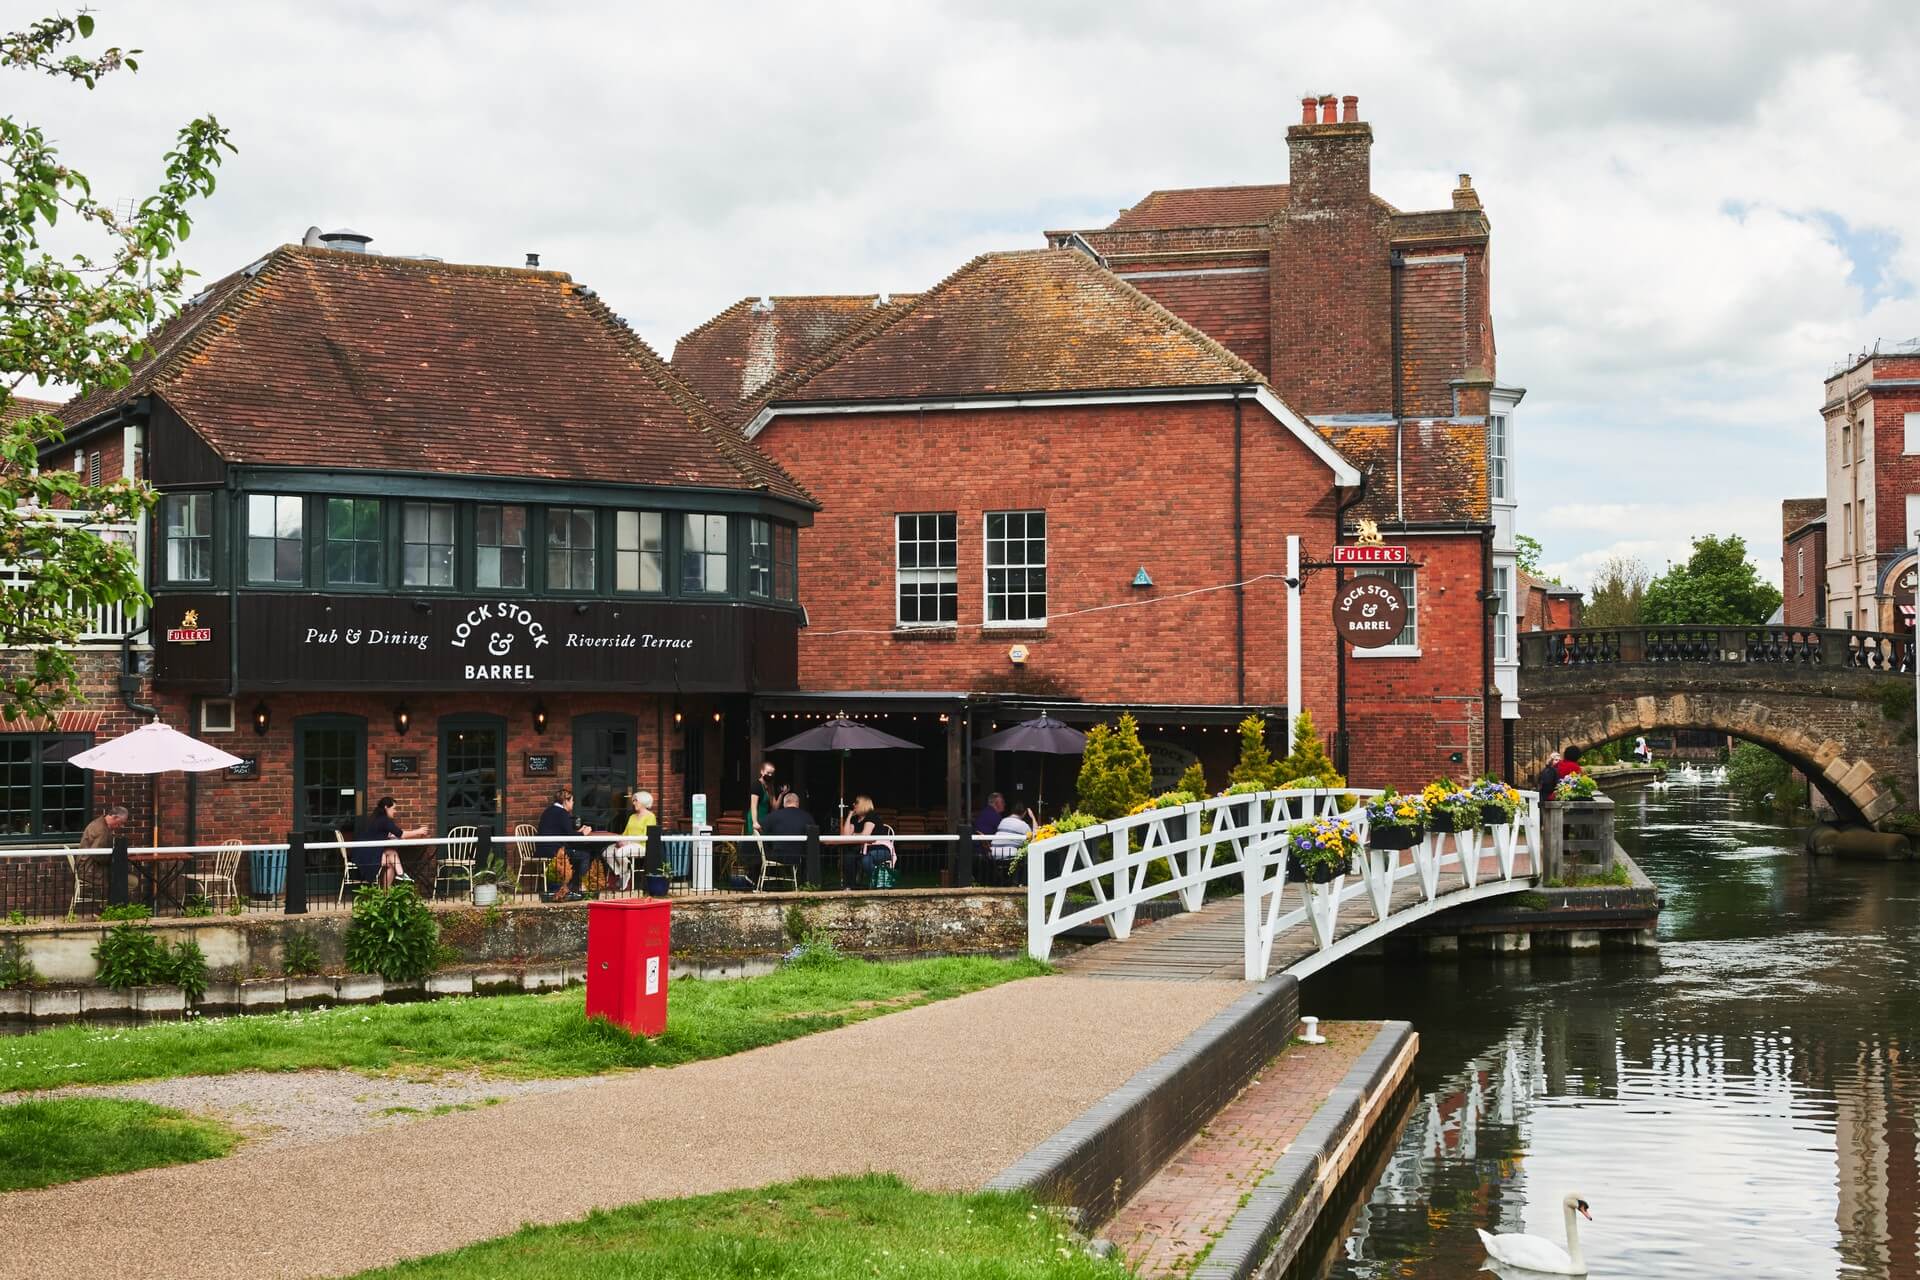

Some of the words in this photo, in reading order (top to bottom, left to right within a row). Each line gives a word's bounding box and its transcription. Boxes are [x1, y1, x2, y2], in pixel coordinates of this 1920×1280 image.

[1337, 548, 1402, 560] FULLER'S
[1341, 586, 1366, 612] LOCK
[1367, 585, 1400, 612] STOCK
[1361, 603, 1379, 618] &
[451, 604, 493, 648] LOCK
[497, 602, 549, 649] STOCK
[1348, 621, 1391, 631] BARREL
[168, 630, 208, 641] FULLER'S
[304, 628, 338, 644] Pub
[345, 628, 362, 645] &
[367, 629, 429, 650] Dining
[566, 633, 637, 648] Riverside
[641, 634, 693, 648] Terrace
[488, 632, 515, 656] &
[465, 665, 535, 680] BARREL
